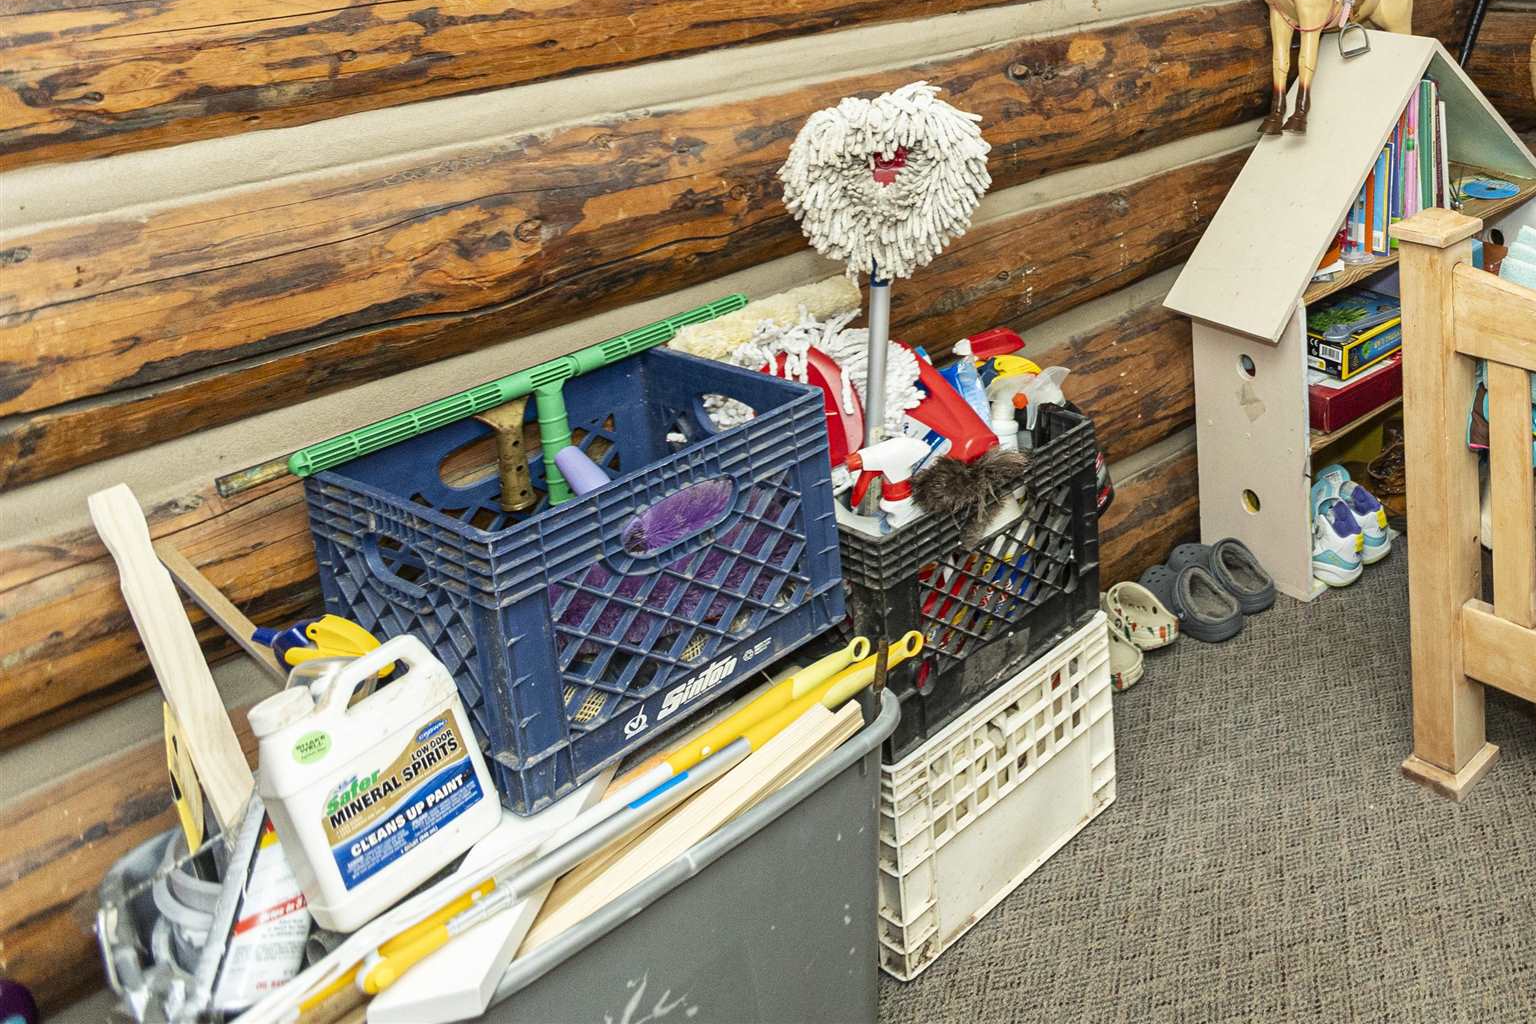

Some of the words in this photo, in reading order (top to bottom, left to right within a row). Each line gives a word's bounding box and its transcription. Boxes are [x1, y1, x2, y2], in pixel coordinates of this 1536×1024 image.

[656, 656, 738, 721] Sinton
[411, 747, 430, 761] LOW
[431, 730, 453, 748] ODOR
[326, 769, 380, 816] Safer
[330, 778, 401, 829] MINERAL
[403, 738, 458, 781] SPIRITS
[351, 815, 406, 856] CLEANS
[405, 801, 425, 821] UP
[426, 774, 464, 807] PAINT
